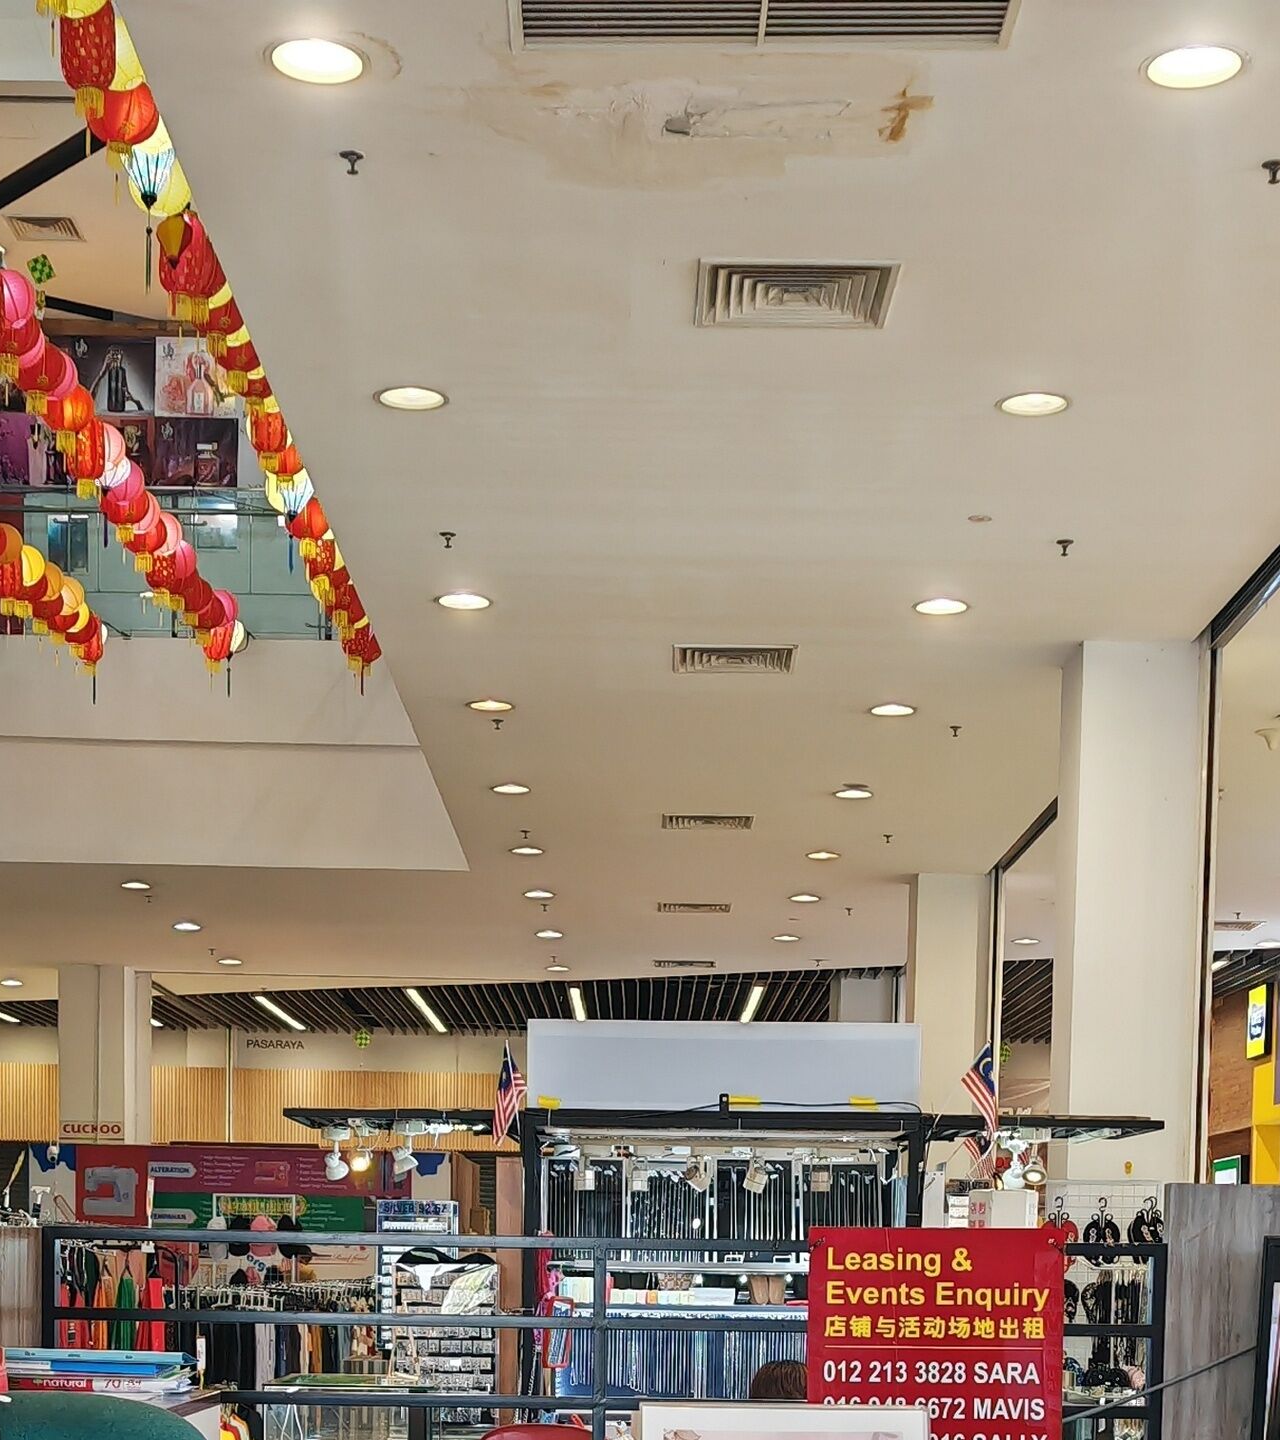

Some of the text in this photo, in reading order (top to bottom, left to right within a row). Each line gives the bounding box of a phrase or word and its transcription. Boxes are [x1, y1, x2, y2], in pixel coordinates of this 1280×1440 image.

[245, 1039, 304, 1051] PASARAYA
[62, 1123, 121, 1136] CUCKOO
[150, 1166, 190, 1174] ALTERATION
[826, 1247, 973, 1278] Leasing &
[826, 1280, 1050, 1312] Events Enquiry
[824, 1316, 1046, 1340] 店铺与活动场地出租
[43, 1378, 87, 1389] natural
[823, 1360, 1041, 1385] 012 213 3828 SARA
[973, 1398, 1046, 1421] MAVIS
